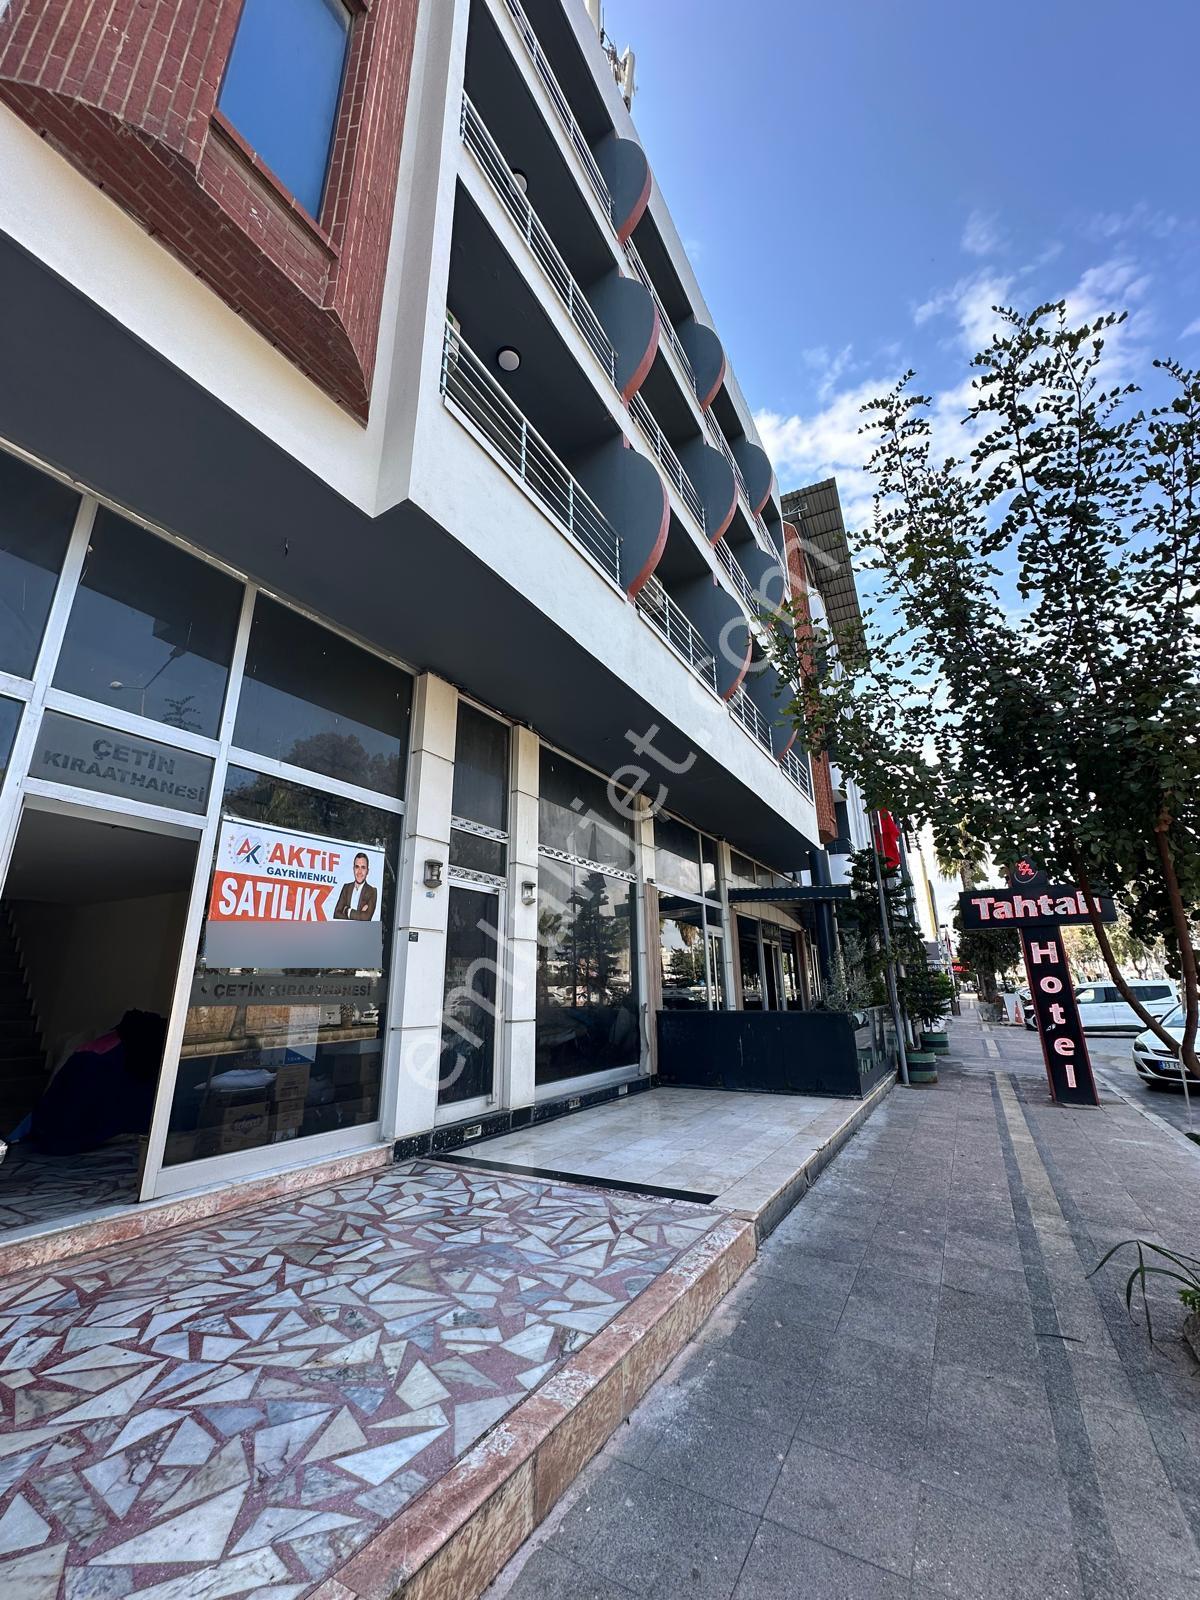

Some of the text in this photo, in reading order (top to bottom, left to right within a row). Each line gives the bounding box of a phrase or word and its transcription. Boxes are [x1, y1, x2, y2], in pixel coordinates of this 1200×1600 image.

[43, 750, 206, 802] KIRAATHANESİ
[93, 739, 175, 775] ÇETİN
[267, 866, 338, 885] GAYRİMENKUL
[219, 877, 321, 921] SATILIK
[214, 982, 264, 999] ÇETİN
[1030, 941, 1077, 1088] Hotel
